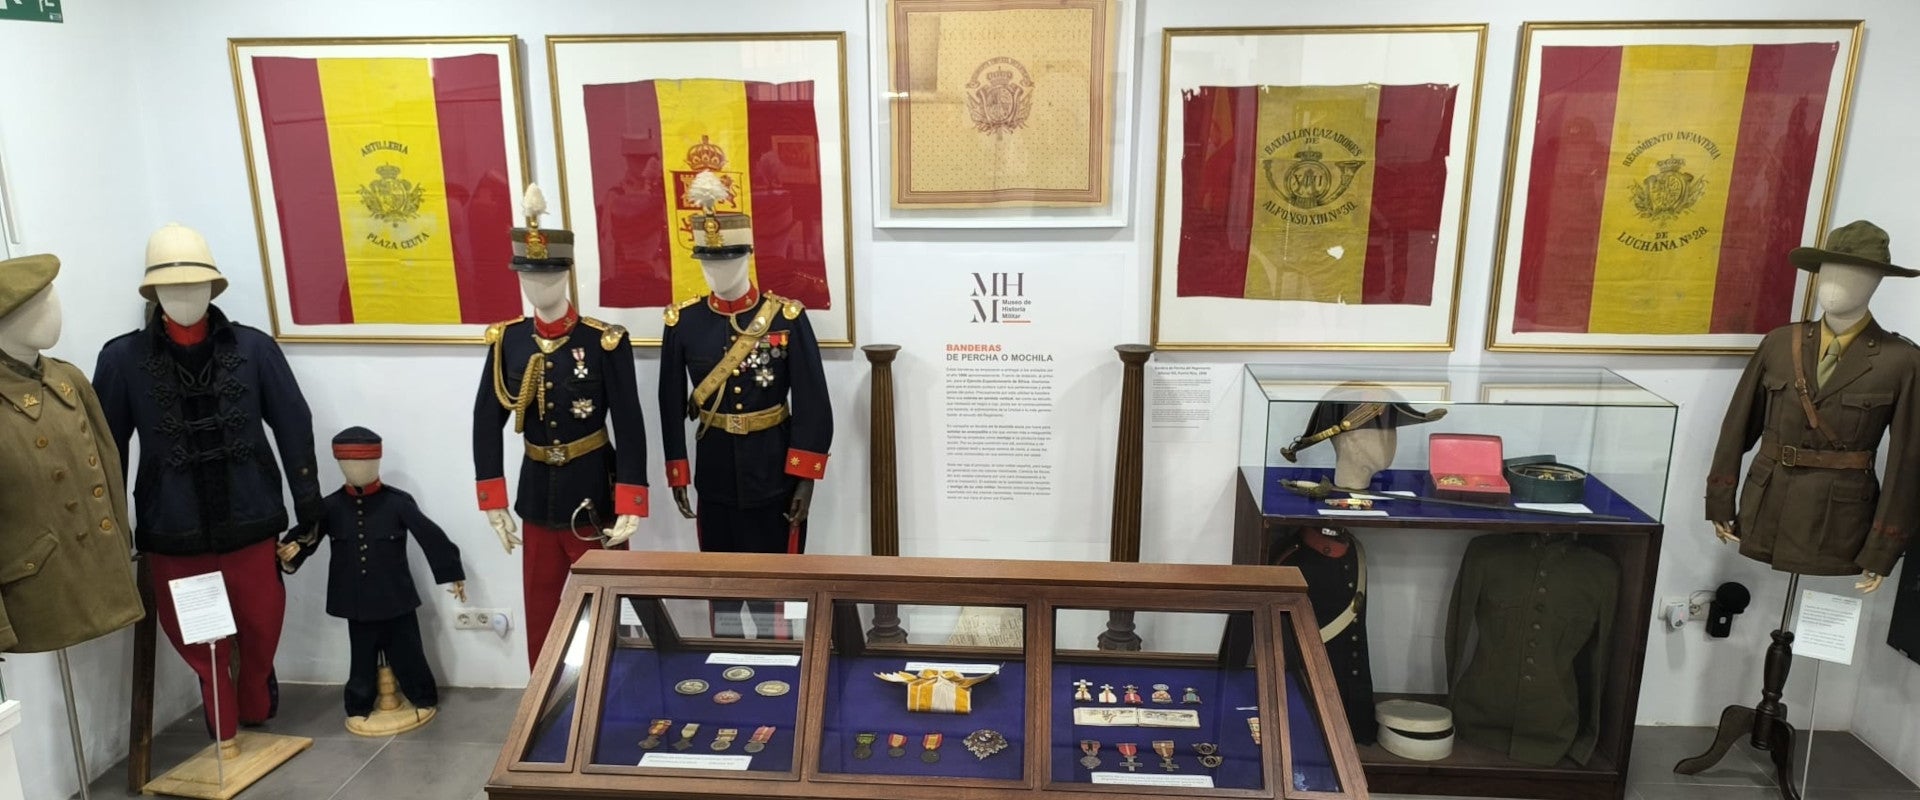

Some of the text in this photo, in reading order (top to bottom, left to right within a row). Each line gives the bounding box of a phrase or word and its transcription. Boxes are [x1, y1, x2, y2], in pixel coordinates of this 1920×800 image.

[1312, 127, 1362, 157] CAZADORES
[1622, 131, 1721, 167] REGIMIENTO INFANTERIA
[1263, 200, 1308, 226] ALFONSO
[367, 232, 430, 250] PLAZA CEUTA
[1617, 231, 1679, 252] LUCHANA
[1692, 226, 1708, 241] 28
[1655, 231, 1669, 240] DE
[970, 272, 1024, 297] MH
[970, 299, 1000, 323] M
[946, 344, 1002, 352] BANDERAS
[946, 353, 959, 361] DE
[961, 353, 999, 361] PERCHA
[1011, 354, 1054, 362] MOCHILA
